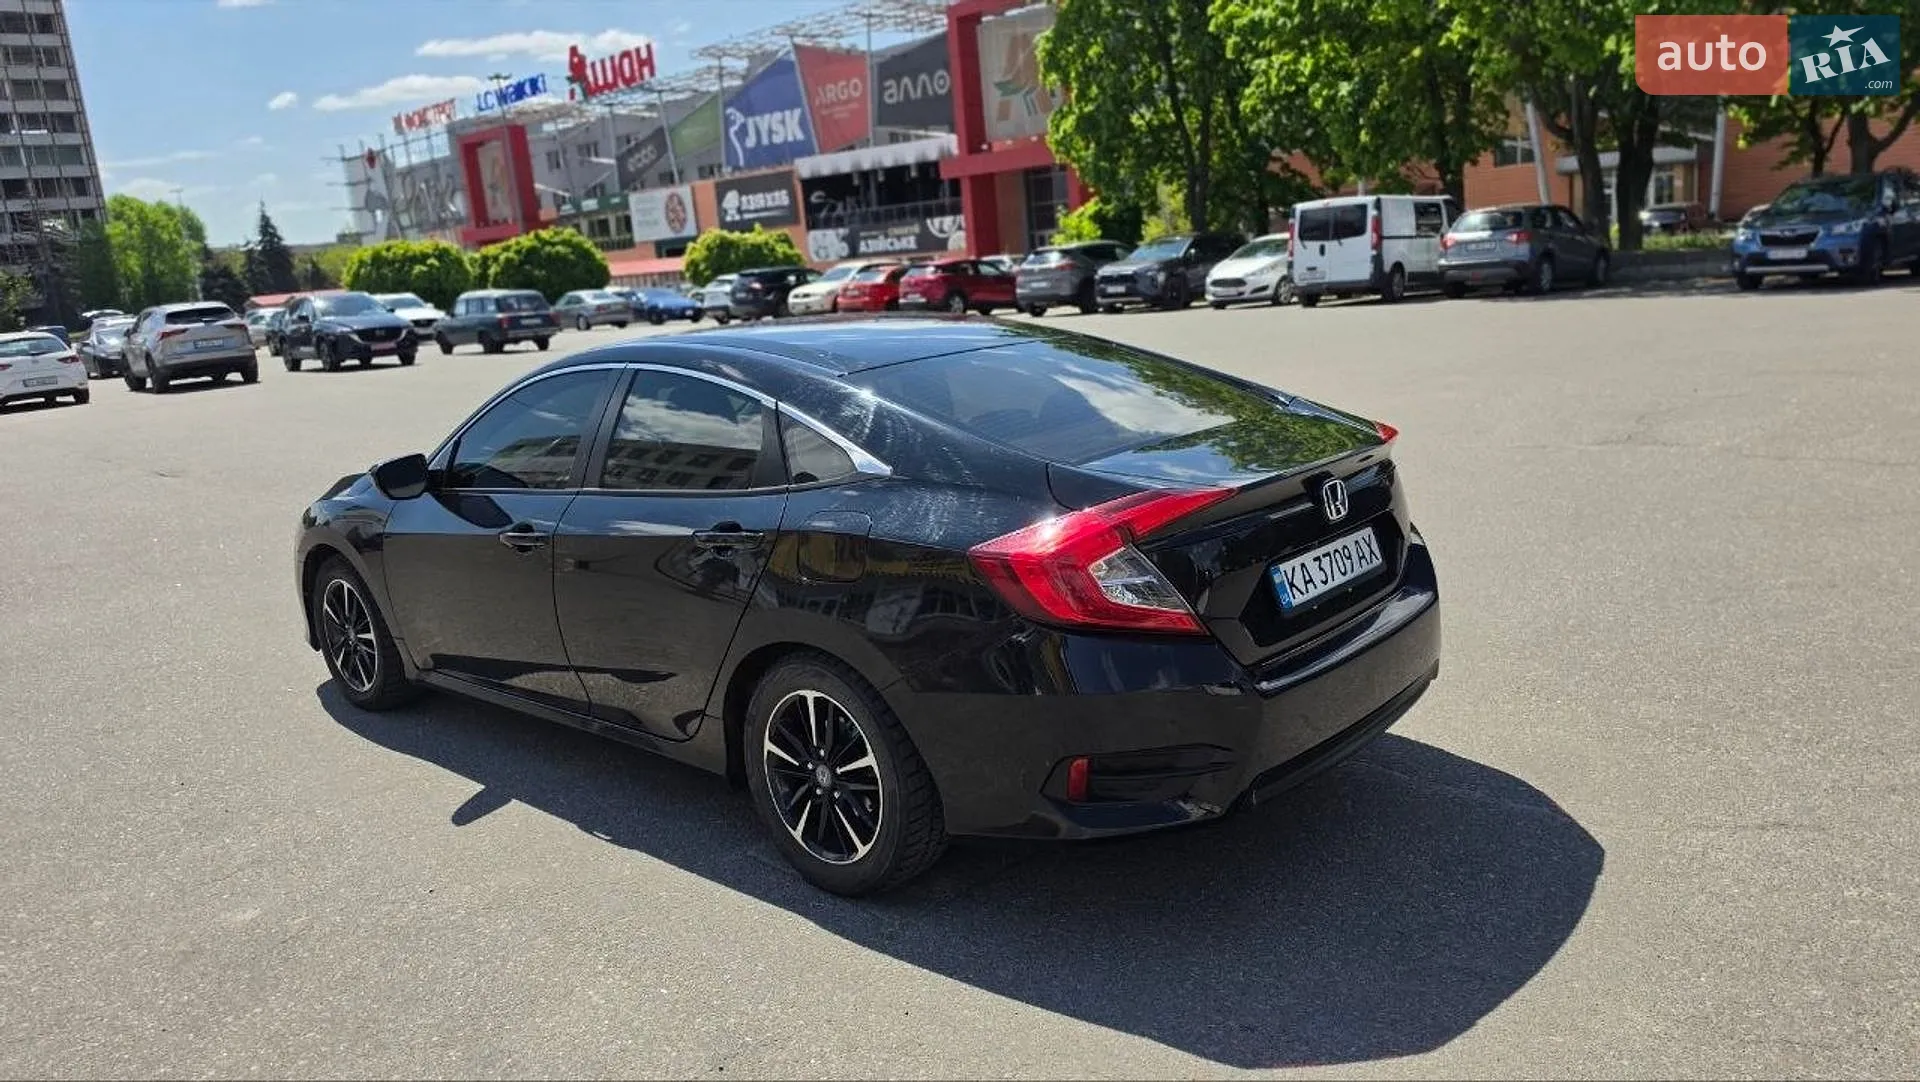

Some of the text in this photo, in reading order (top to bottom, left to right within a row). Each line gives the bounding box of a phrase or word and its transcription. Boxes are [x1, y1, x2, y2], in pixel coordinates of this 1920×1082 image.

[476, 91, 495, 112] LC
[815, 77, 862, 106] ARGO
[745, 108, 804, 149] JYSK
[1283, 534, 1380, 600] KA 3709 AX
